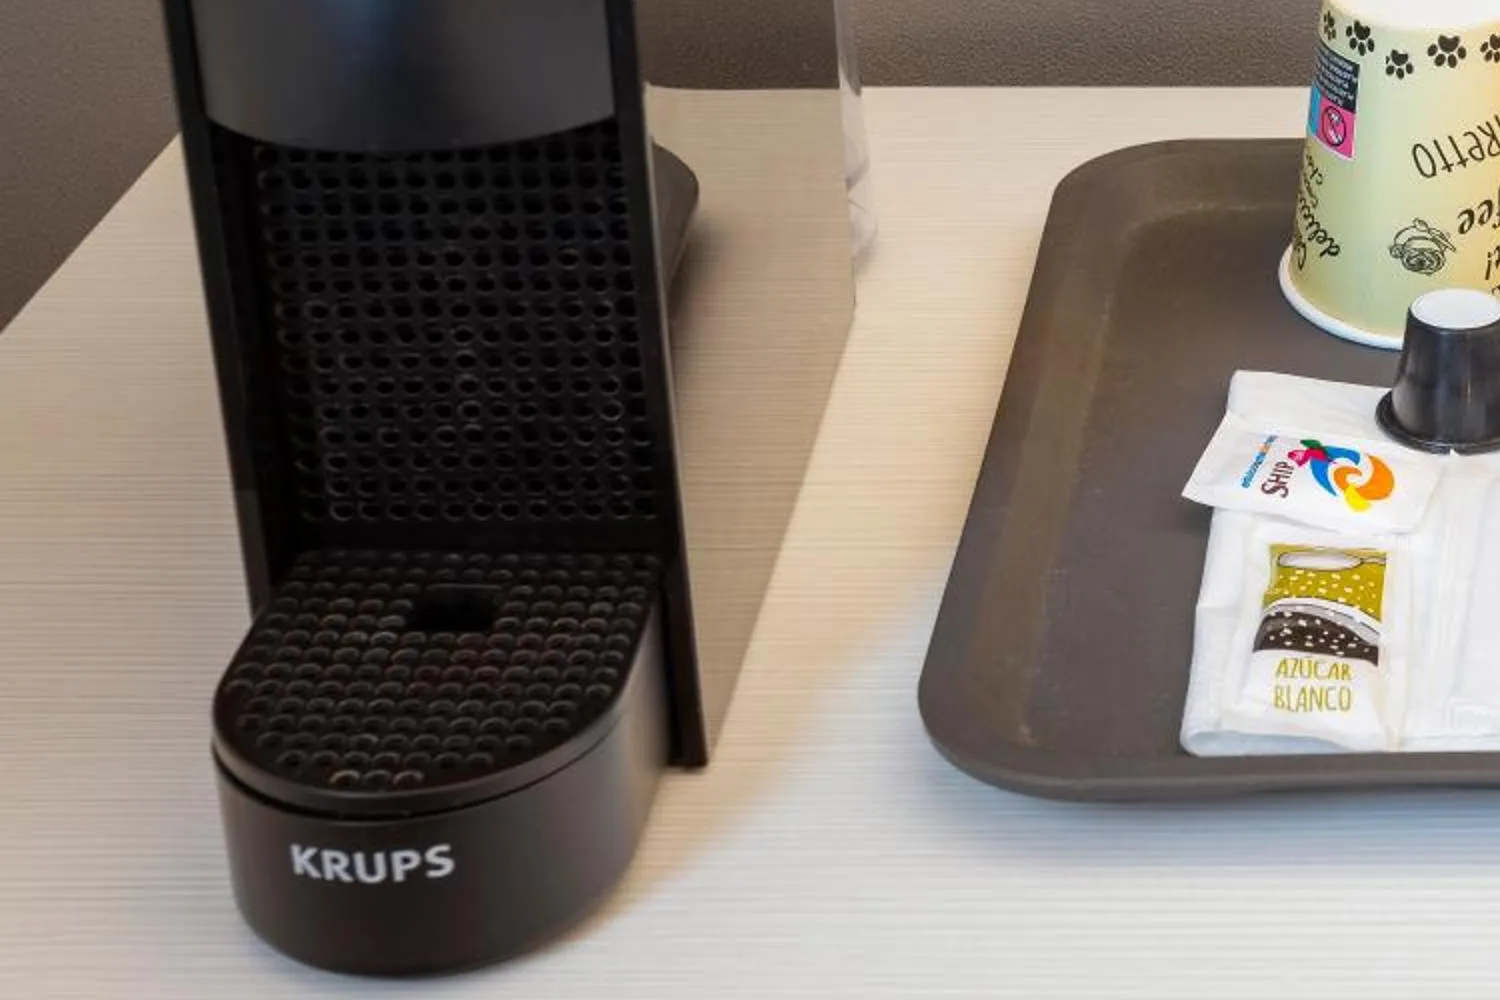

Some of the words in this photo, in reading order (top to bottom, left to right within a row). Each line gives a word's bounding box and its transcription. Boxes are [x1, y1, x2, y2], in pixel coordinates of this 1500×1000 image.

[1261, 461, 1295, 499] SHIP
[1275, 656, 1352, 681] AZÚCAR
[1274, 685, 1351, 712] BLANCO
[290, 843, 455, 884] KRUPS
